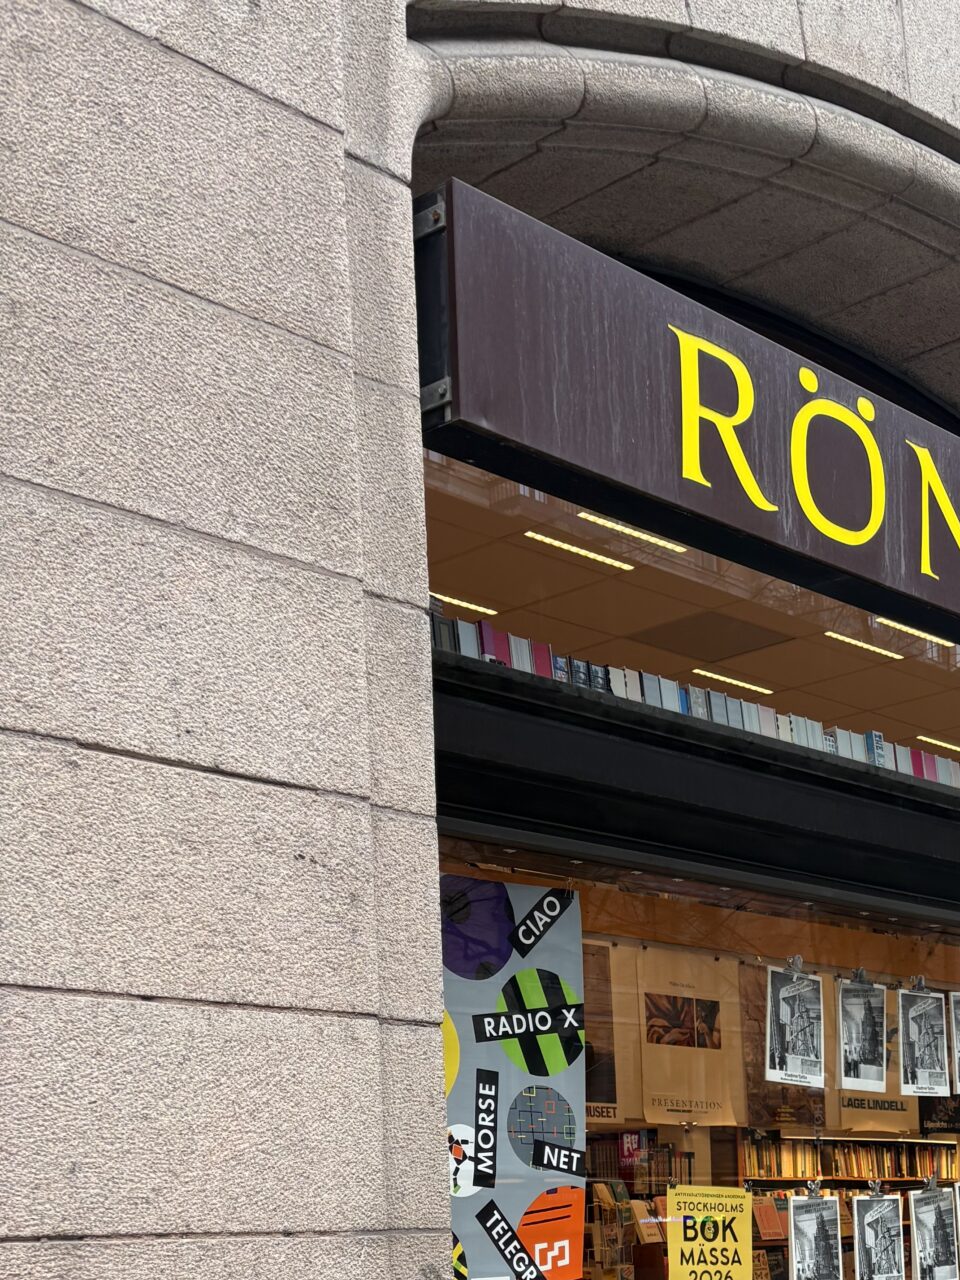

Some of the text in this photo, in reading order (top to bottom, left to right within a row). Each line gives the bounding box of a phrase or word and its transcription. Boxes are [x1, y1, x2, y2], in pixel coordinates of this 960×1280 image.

[518, 896, 560, 945] CIAO
[483, 1008, 579, 1037] RADIO X
[651, 1097, 723, 1110] PRESENTATION
[841, 1096, 908, 1112] LAGE LINDELL
[477, 1083, 496, 1174] MORSE
[543, 1145, 580, 1171] NET
[676, 1200, 744, 1213] STOCKHOLMS
[682, 1215, 738, 1243] BOK
[680, 1243, 742, 1266] MÄSSA
